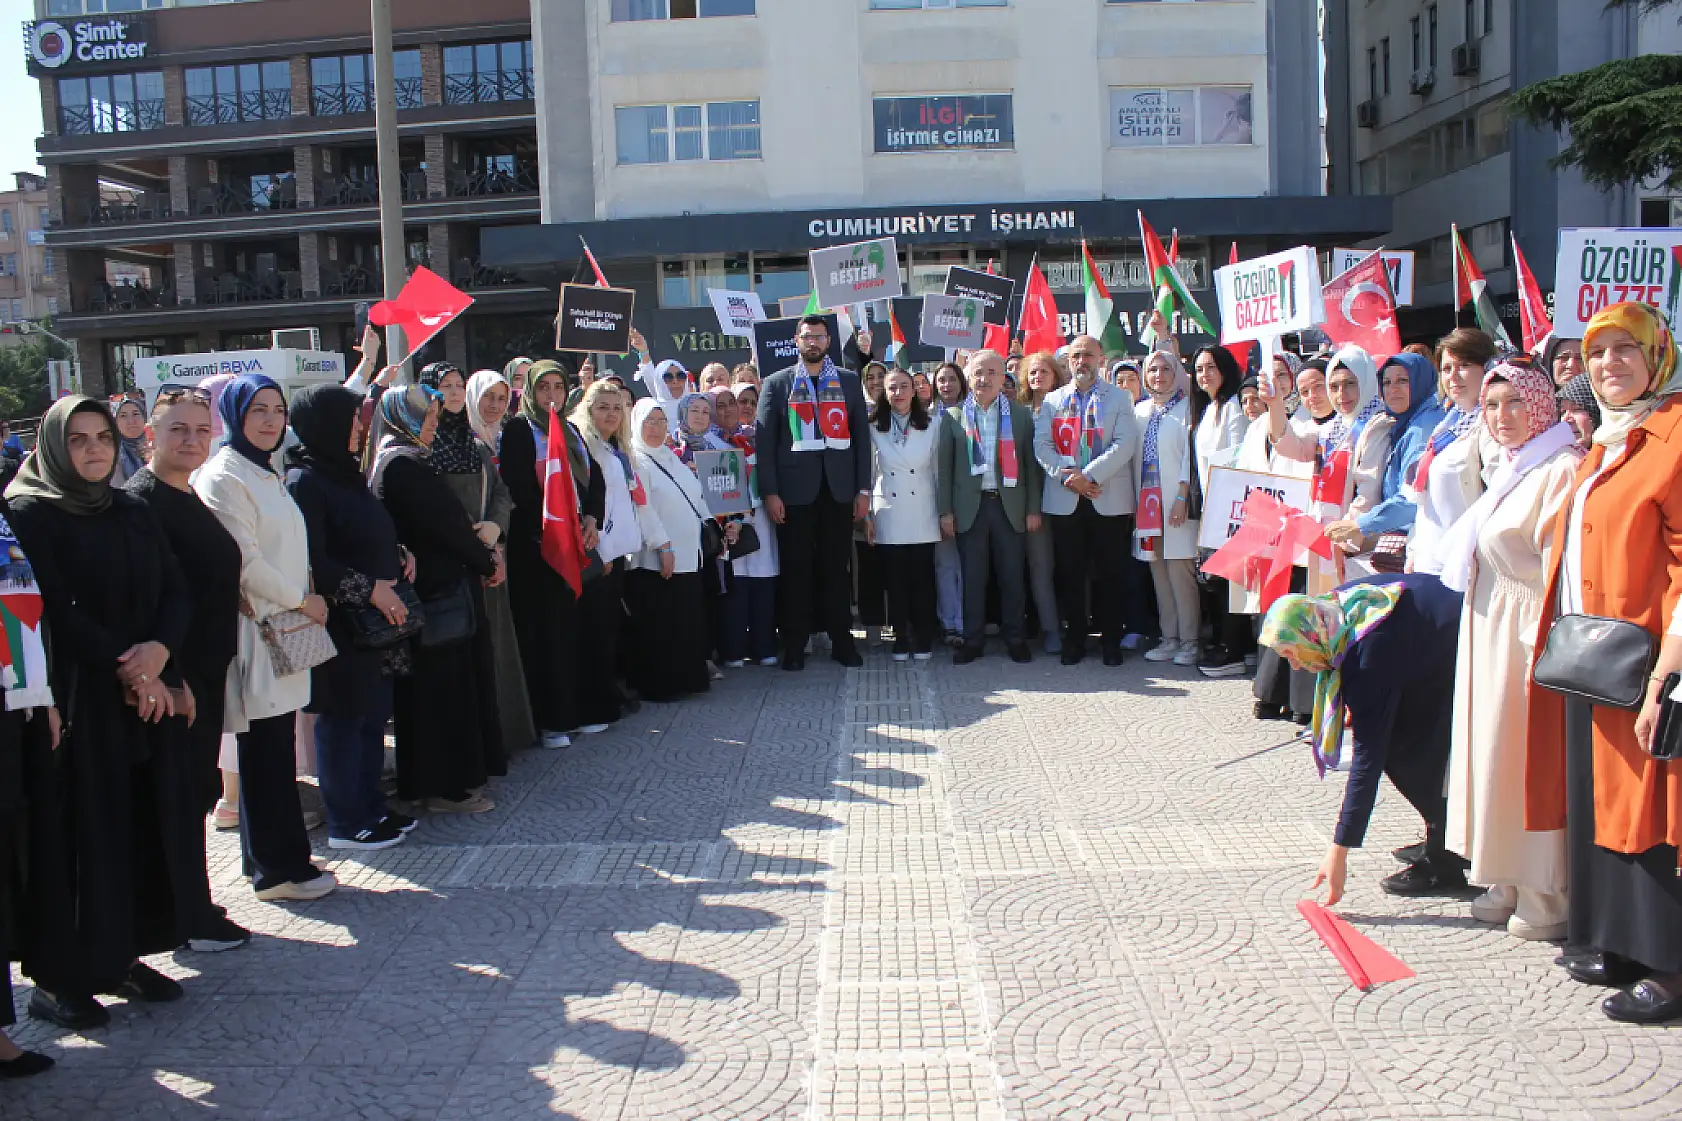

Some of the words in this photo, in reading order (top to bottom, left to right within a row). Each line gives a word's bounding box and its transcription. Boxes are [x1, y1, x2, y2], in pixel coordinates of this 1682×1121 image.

[74, 20, 126, 41] Simit
[76, 41, 147, 60] Center
[943, 126, 1000, 145] CİHAZI
[808, 211, 976, 238] CUMHURİYET
[991, 209, 1075, 235] İŞHANI
[1580, 239, 1666, 284] ÖZGÜR
[1234, 264, 1277, 301] ÖZGÜR
[1235, 294, 1280, 331] GAZZE
[172, 362, 218, 378] Garanti
[220, 358, 263, 374] BBVA
